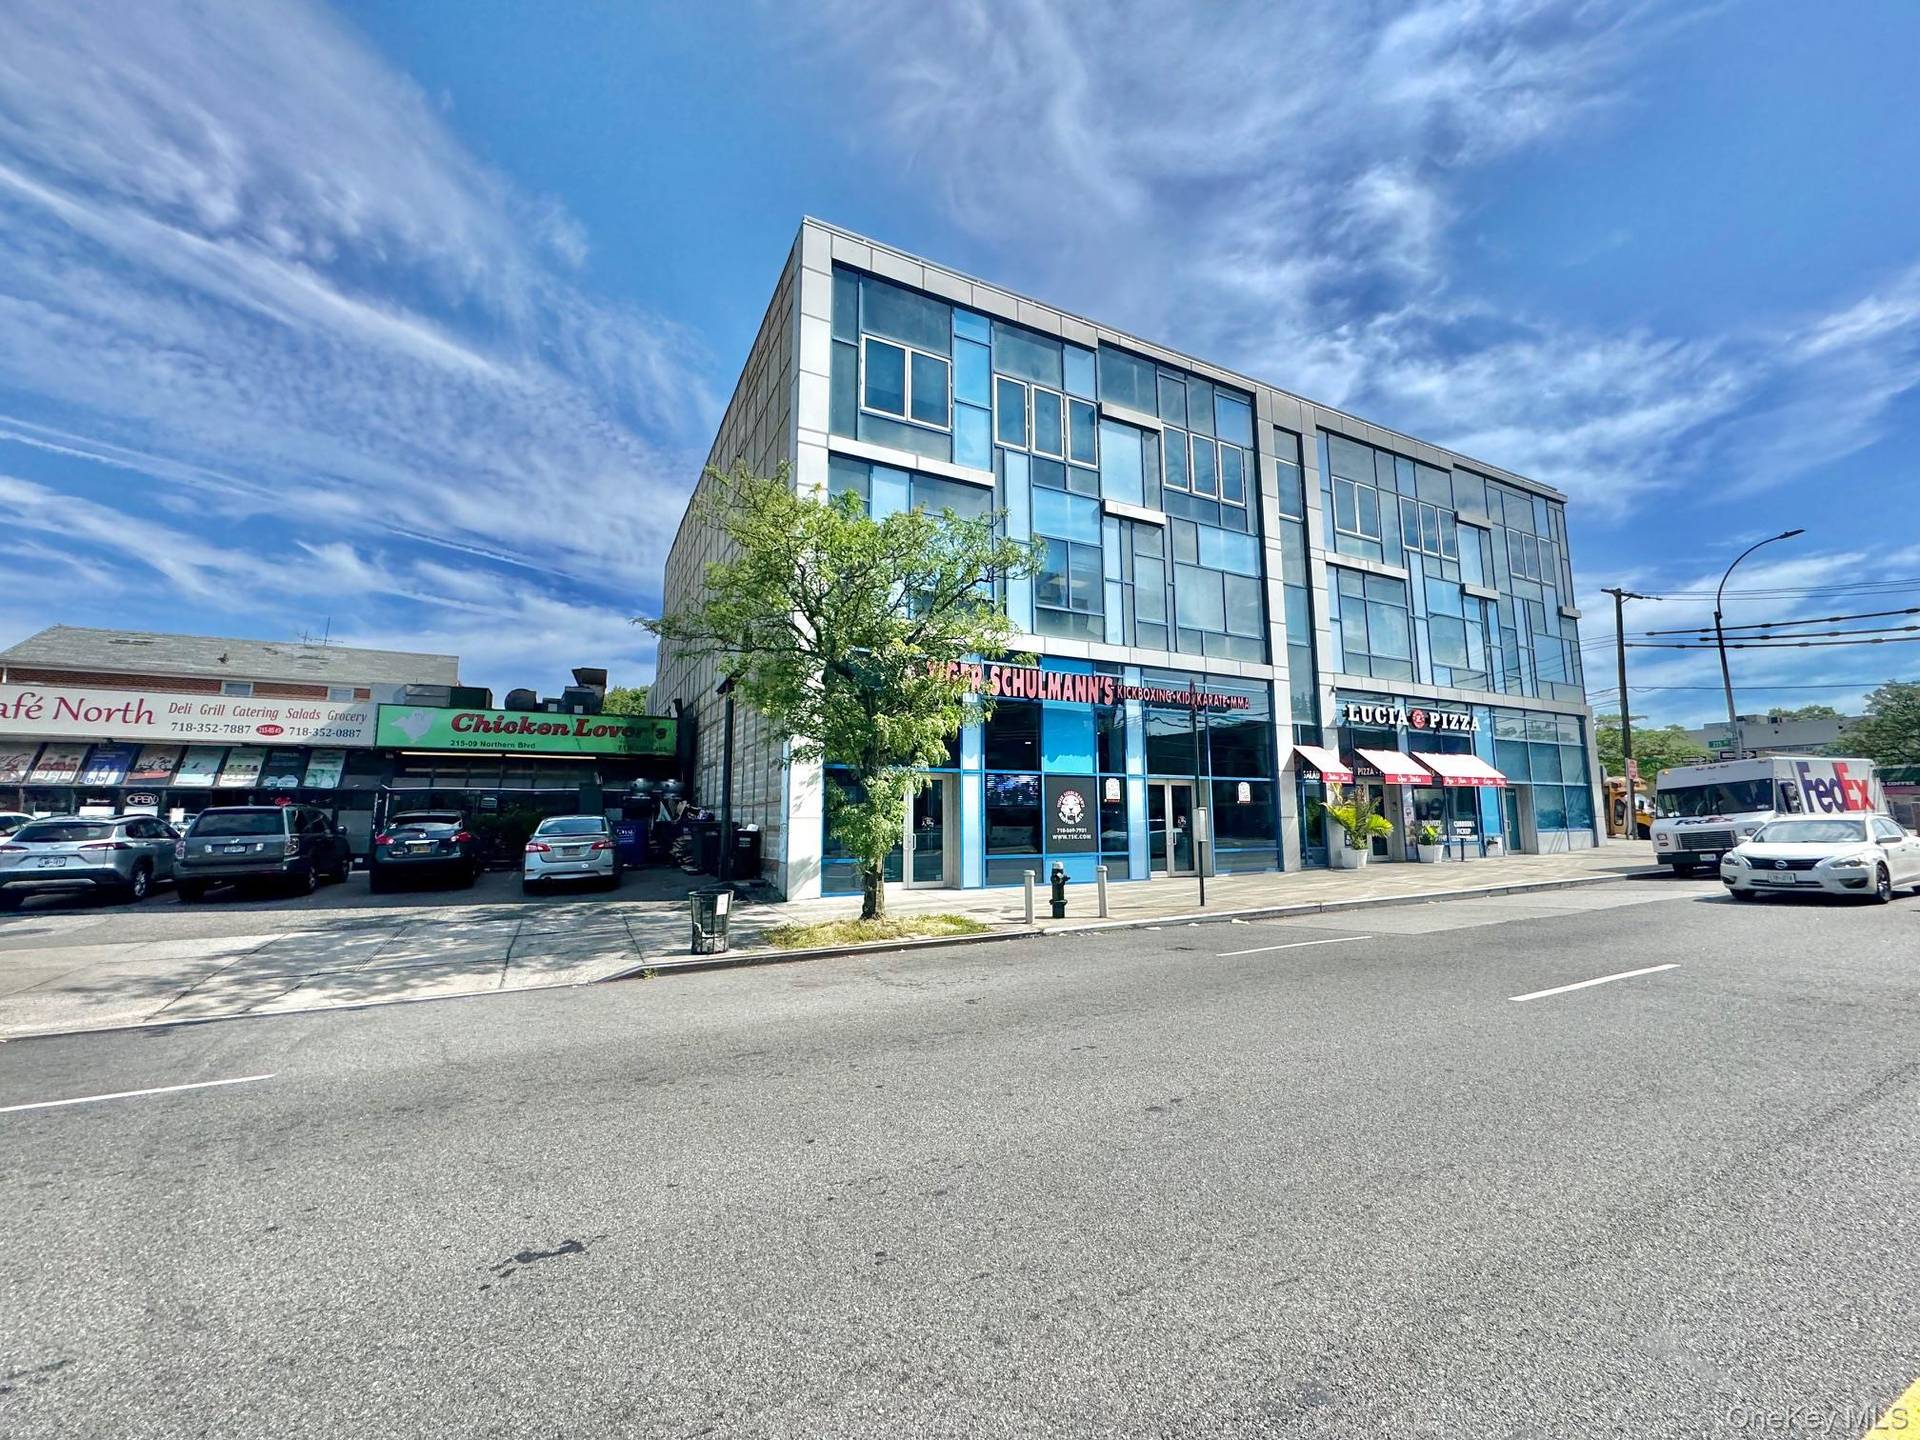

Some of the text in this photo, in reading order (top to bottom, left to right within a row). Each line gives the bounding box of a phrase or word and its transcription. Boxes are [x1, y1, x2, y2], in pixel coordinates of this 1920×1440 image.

[989, 665, 1114, 705] SCHULMANN'S
[1117, 685, 1173, 703] KICKBOXING
[1176, 691, 1197, 705] KID
[1197, 693, 1228, 708] KARATE
[1230, 696, 1250, 710] MMA
[52, 696, 155, 725] North
[168, 702, 368, 724] Deli Grill Catering Salads Grocery
[1347, 704, 1408, 726] LUCIA
[1429, 712, 1481, 732] PIZZA
[171, 722, 251, 734] 718-352-7887
[289, 727, 362, 738] 718-352-0887
[451, 713, 570, 736] Chicken
[1357, 767, 1375, 776] PIZZA
[1796, 762, 1875, 814] FedEx
[132, 794, 157, 805] OPEN
[1674, 816, 1736, 826] FedEx
